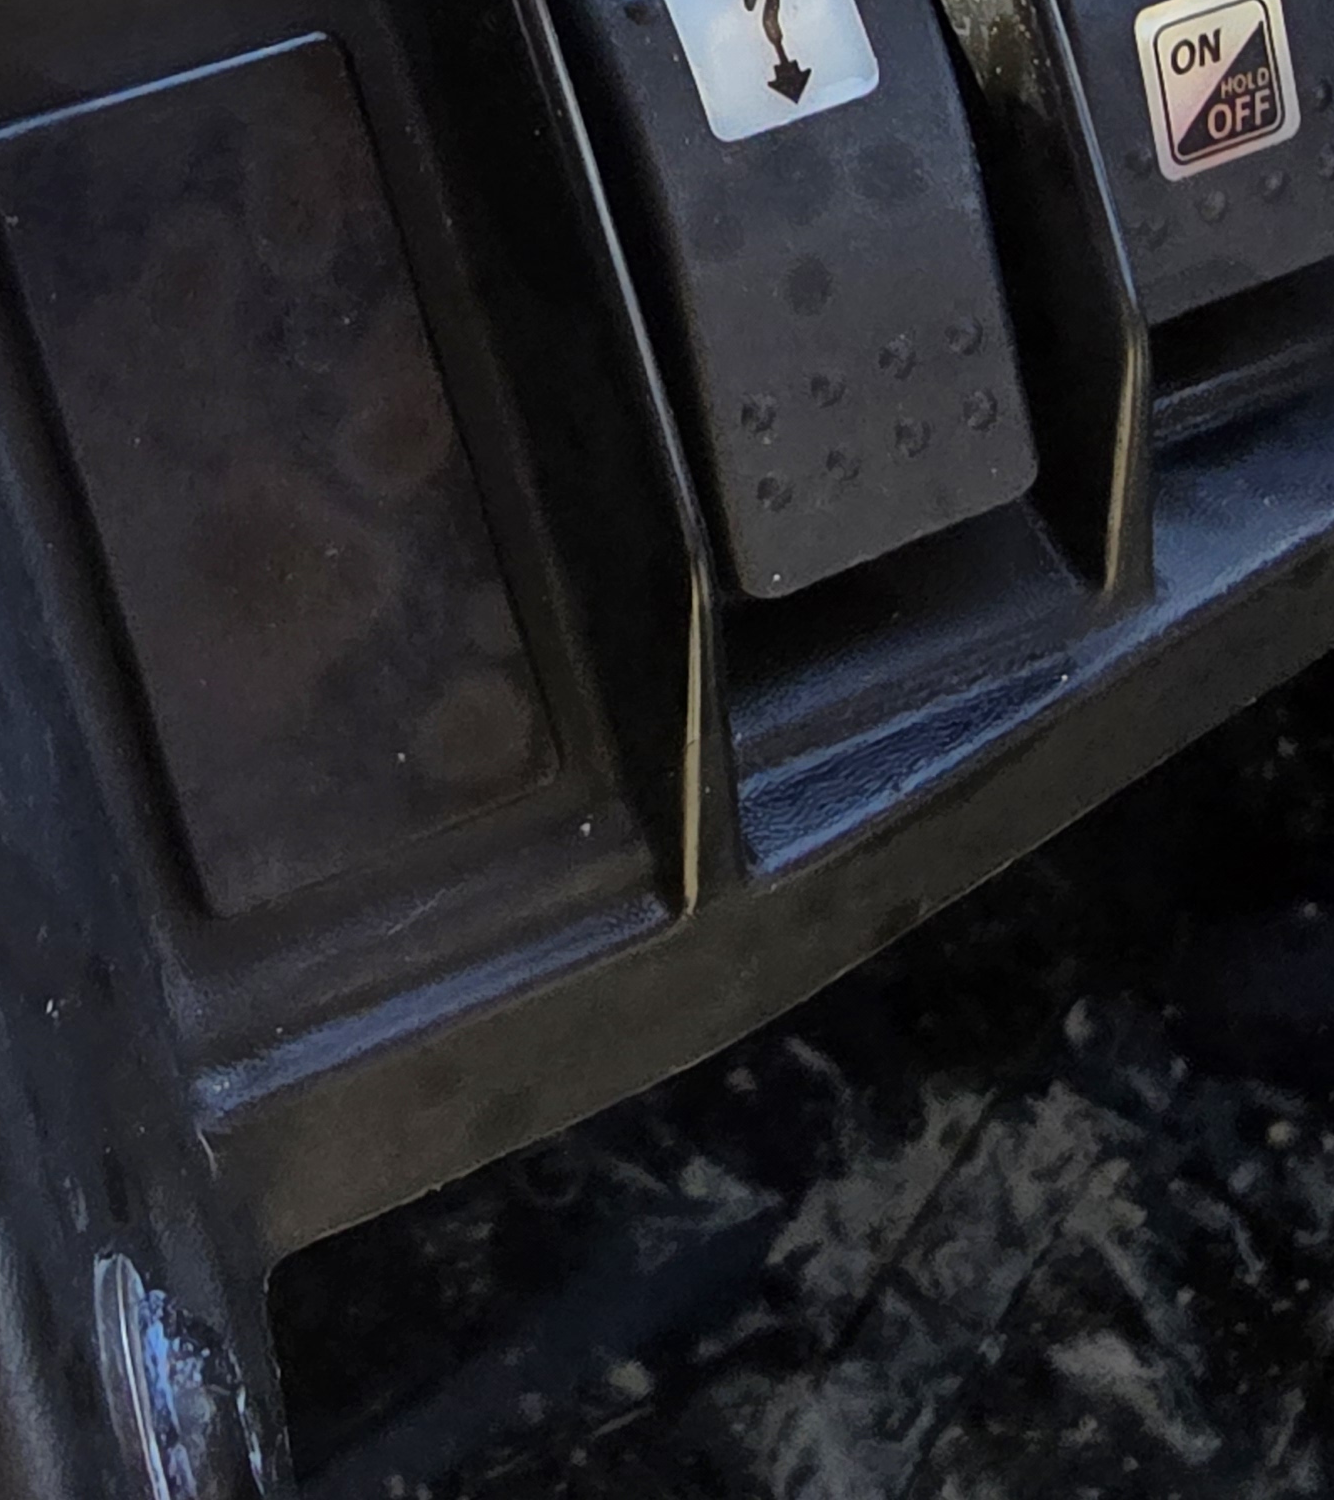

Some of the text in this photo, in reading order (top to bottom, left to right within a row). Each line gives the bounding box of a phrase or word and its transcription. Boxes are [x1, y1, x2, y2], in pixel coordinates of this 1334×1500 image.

[1171, 27, 1222, 75] ON
[1220, 67, 1270, 99] HOLD
[1207, 88, 1271, 140] OFF
